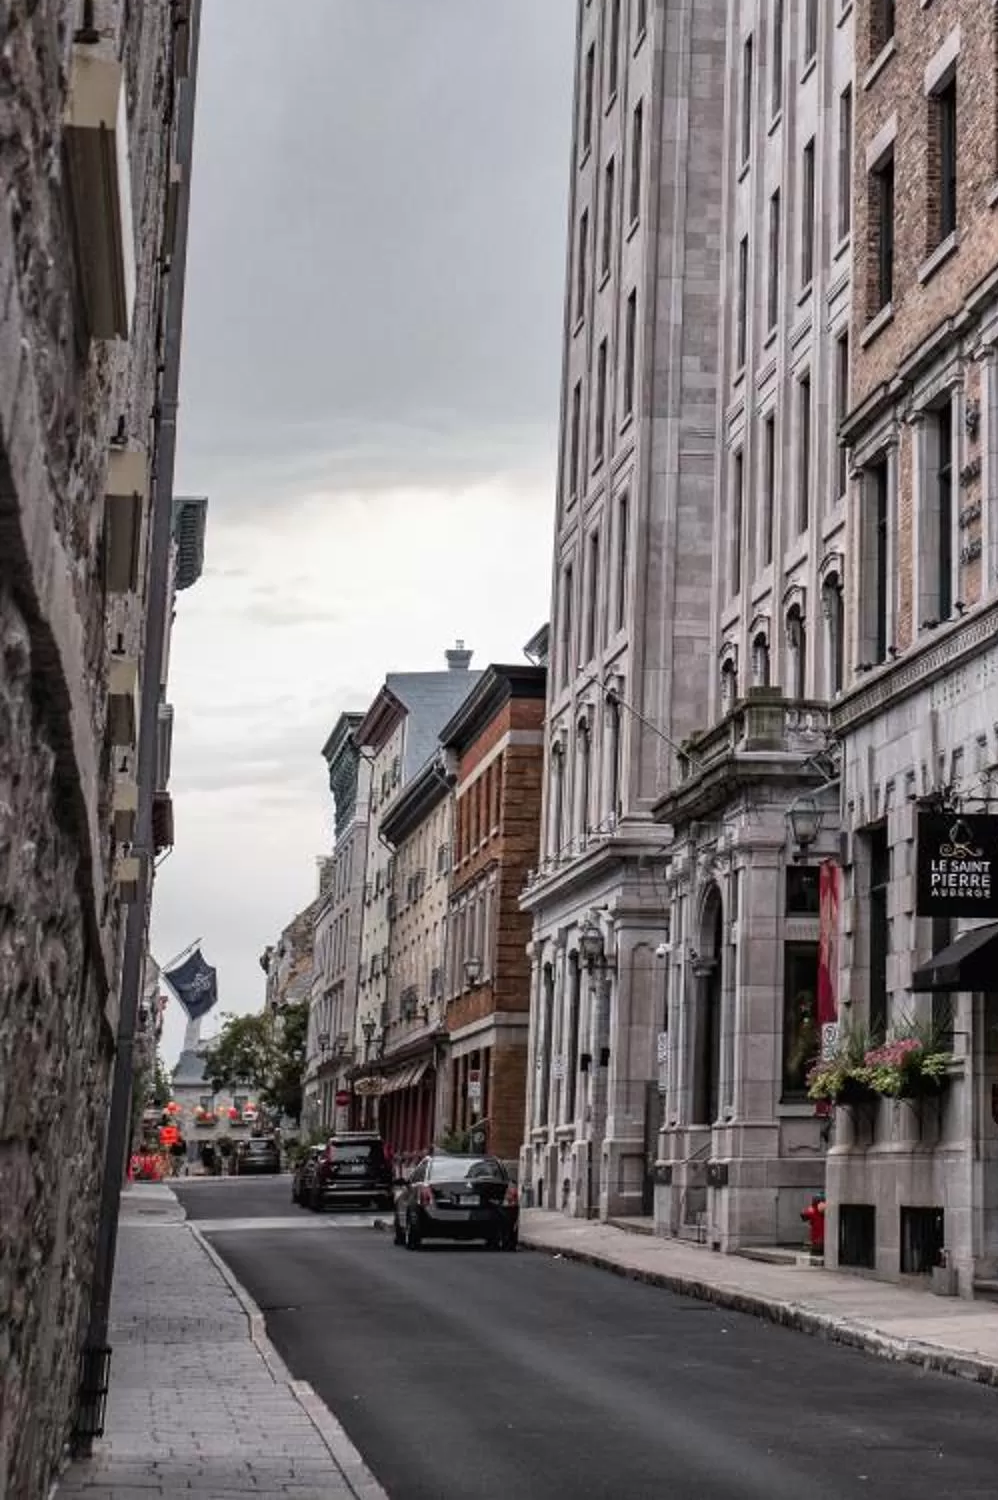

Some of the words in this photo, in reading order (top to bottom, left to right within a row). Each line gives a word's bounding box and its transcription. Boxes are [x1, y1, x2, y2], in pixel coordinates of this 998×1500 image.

[931, 859, 947, 872] LE
[950, 860, 991, 873] SAINT
[931, 873, 991, 887] PIERRE
[931, 887, 991, 899] AUBERGE
